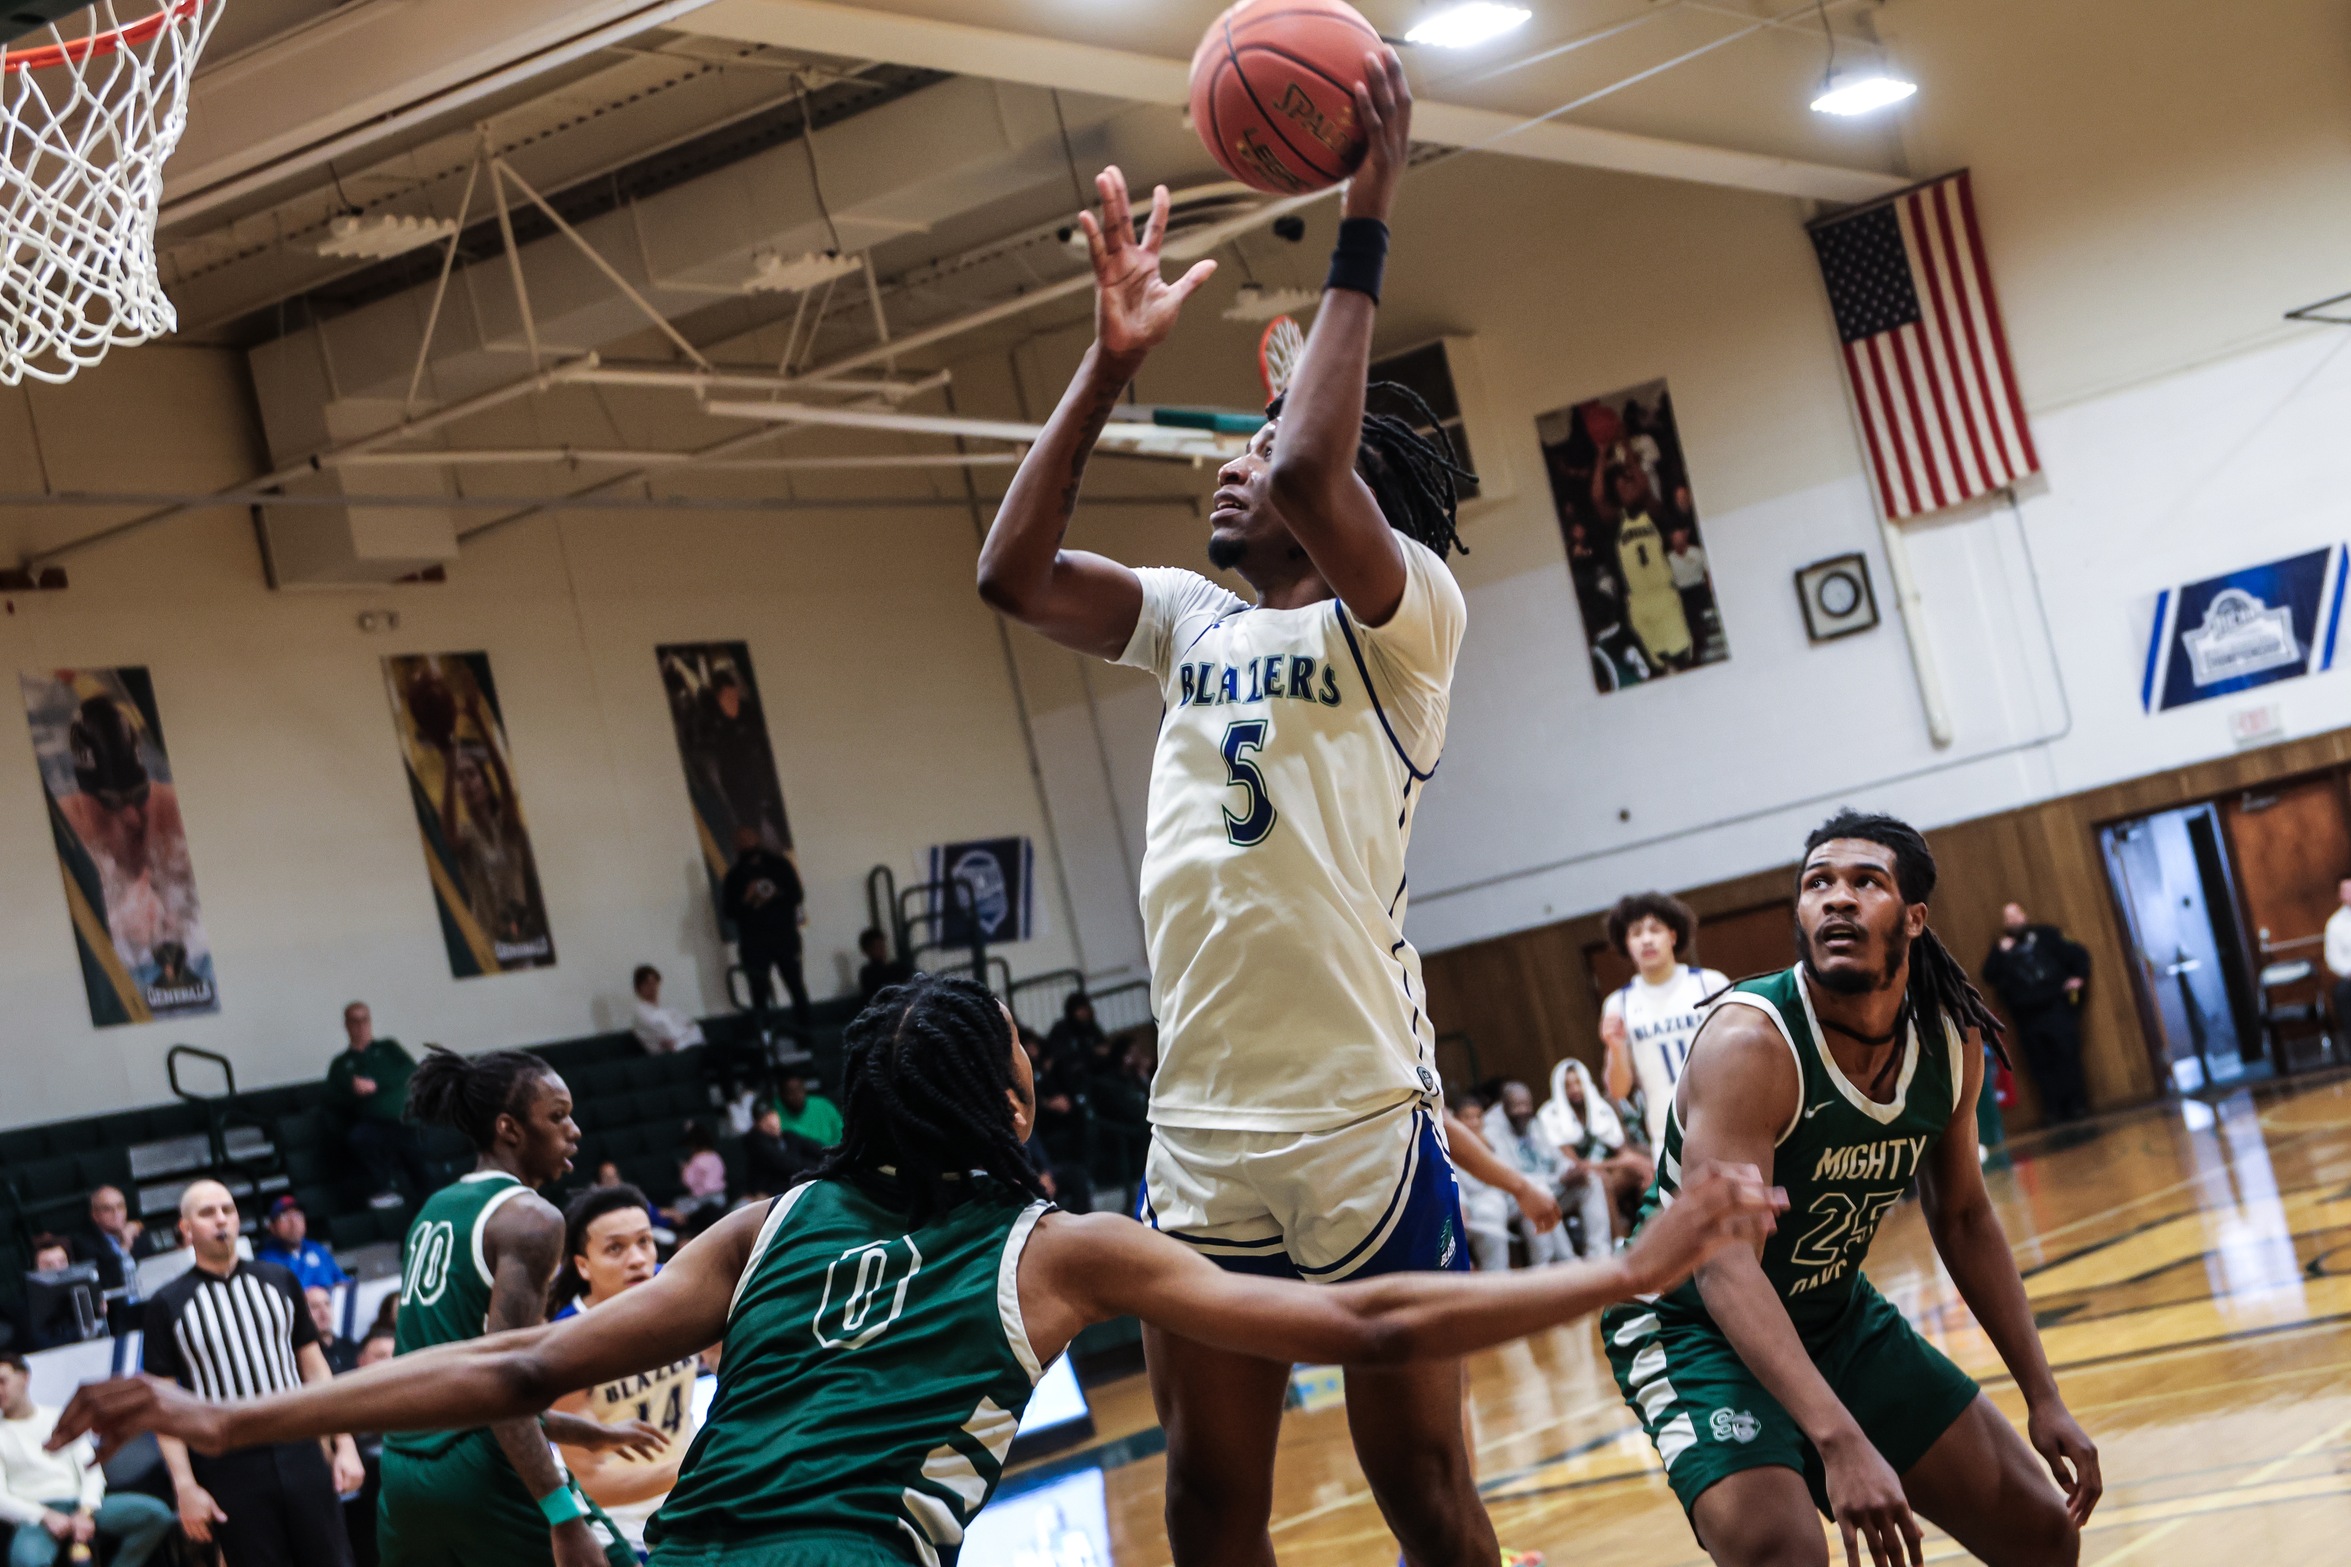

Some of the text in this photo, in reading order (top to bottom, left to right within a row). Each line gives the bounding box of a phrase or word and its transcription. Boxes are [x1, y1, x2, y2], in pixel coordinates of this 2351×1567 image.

[1220, 719, 1277, 847] 5
[1811, 1135, 1927, 1182] MIGHTY
[401, 1220, 454, 1306] 10
[1791, 1188, 1904, 1265] 25
[812, 1235, 922, 1350] 0
[636, 1384, 683, 1434] 14
